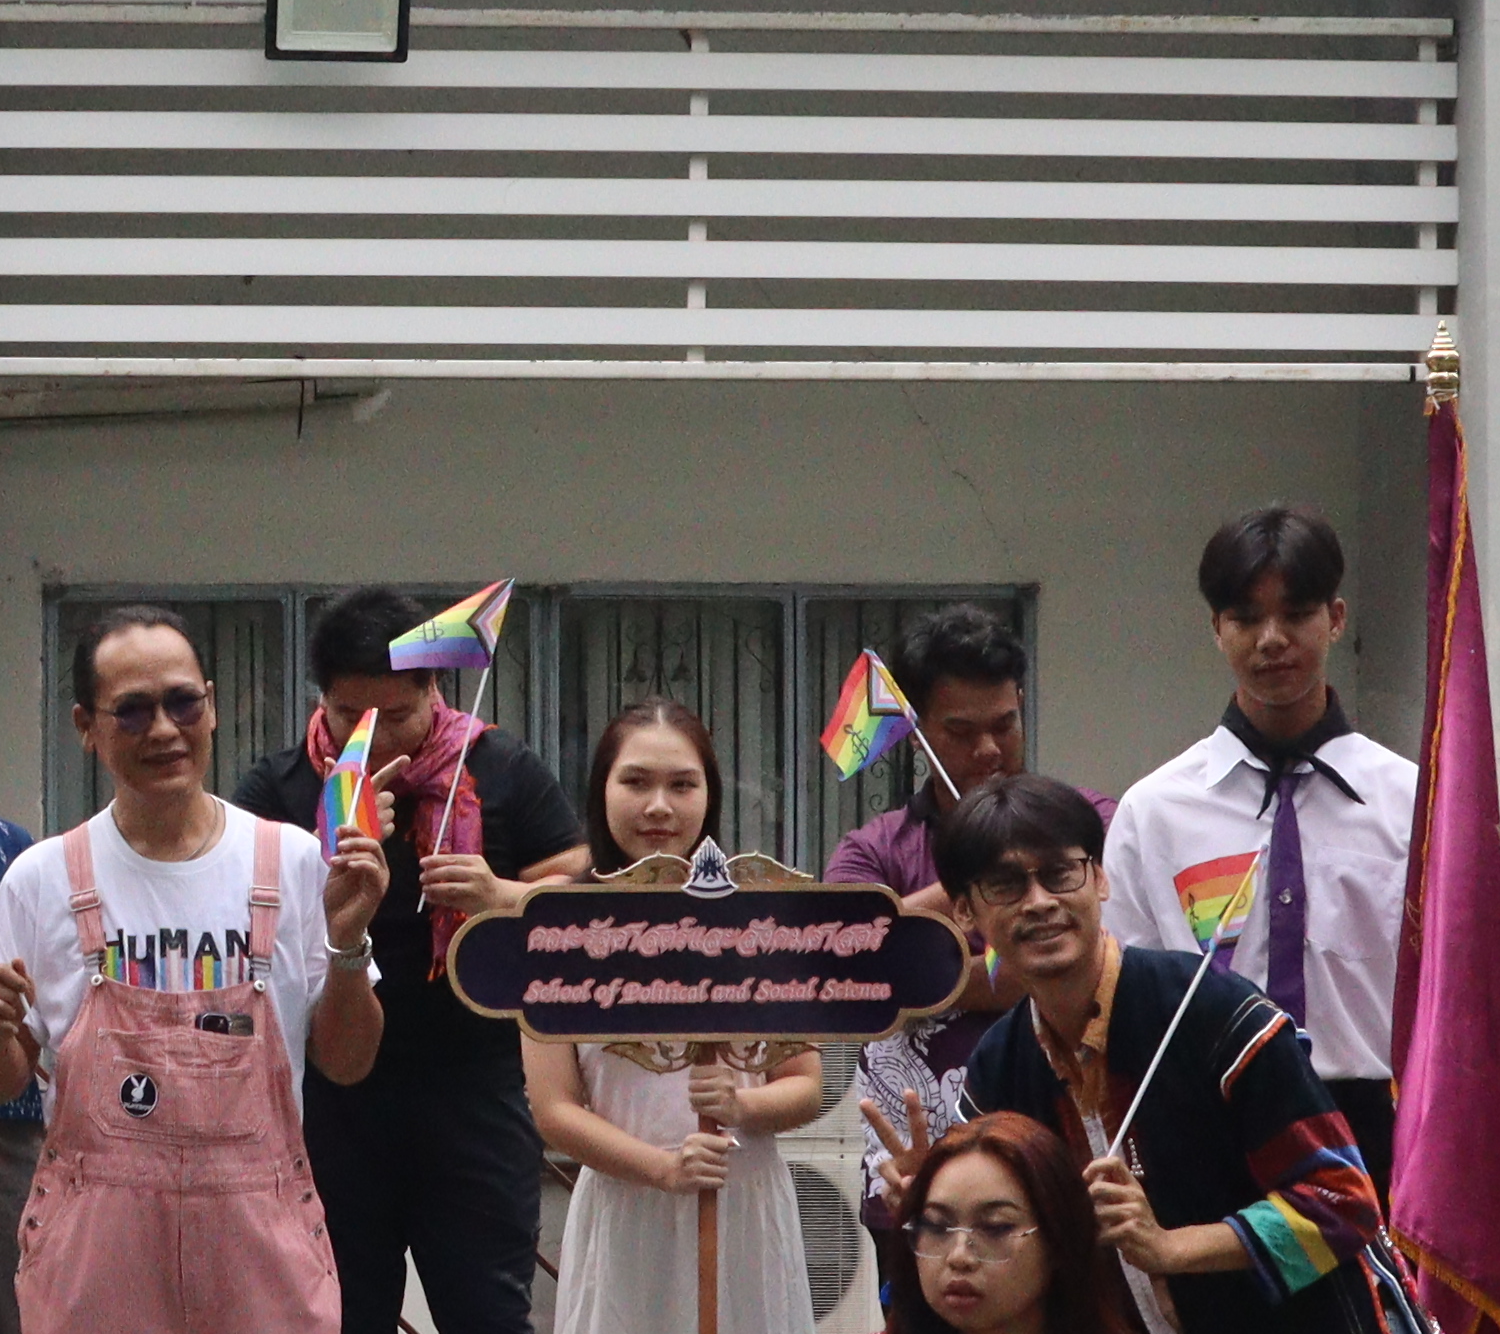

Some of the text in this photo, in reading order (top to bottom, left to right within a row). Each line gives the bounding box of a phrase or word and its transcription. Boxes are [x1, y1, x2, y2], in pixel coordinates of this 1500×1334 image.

[523, 976, 892, 1010] School of Political and Social Science
